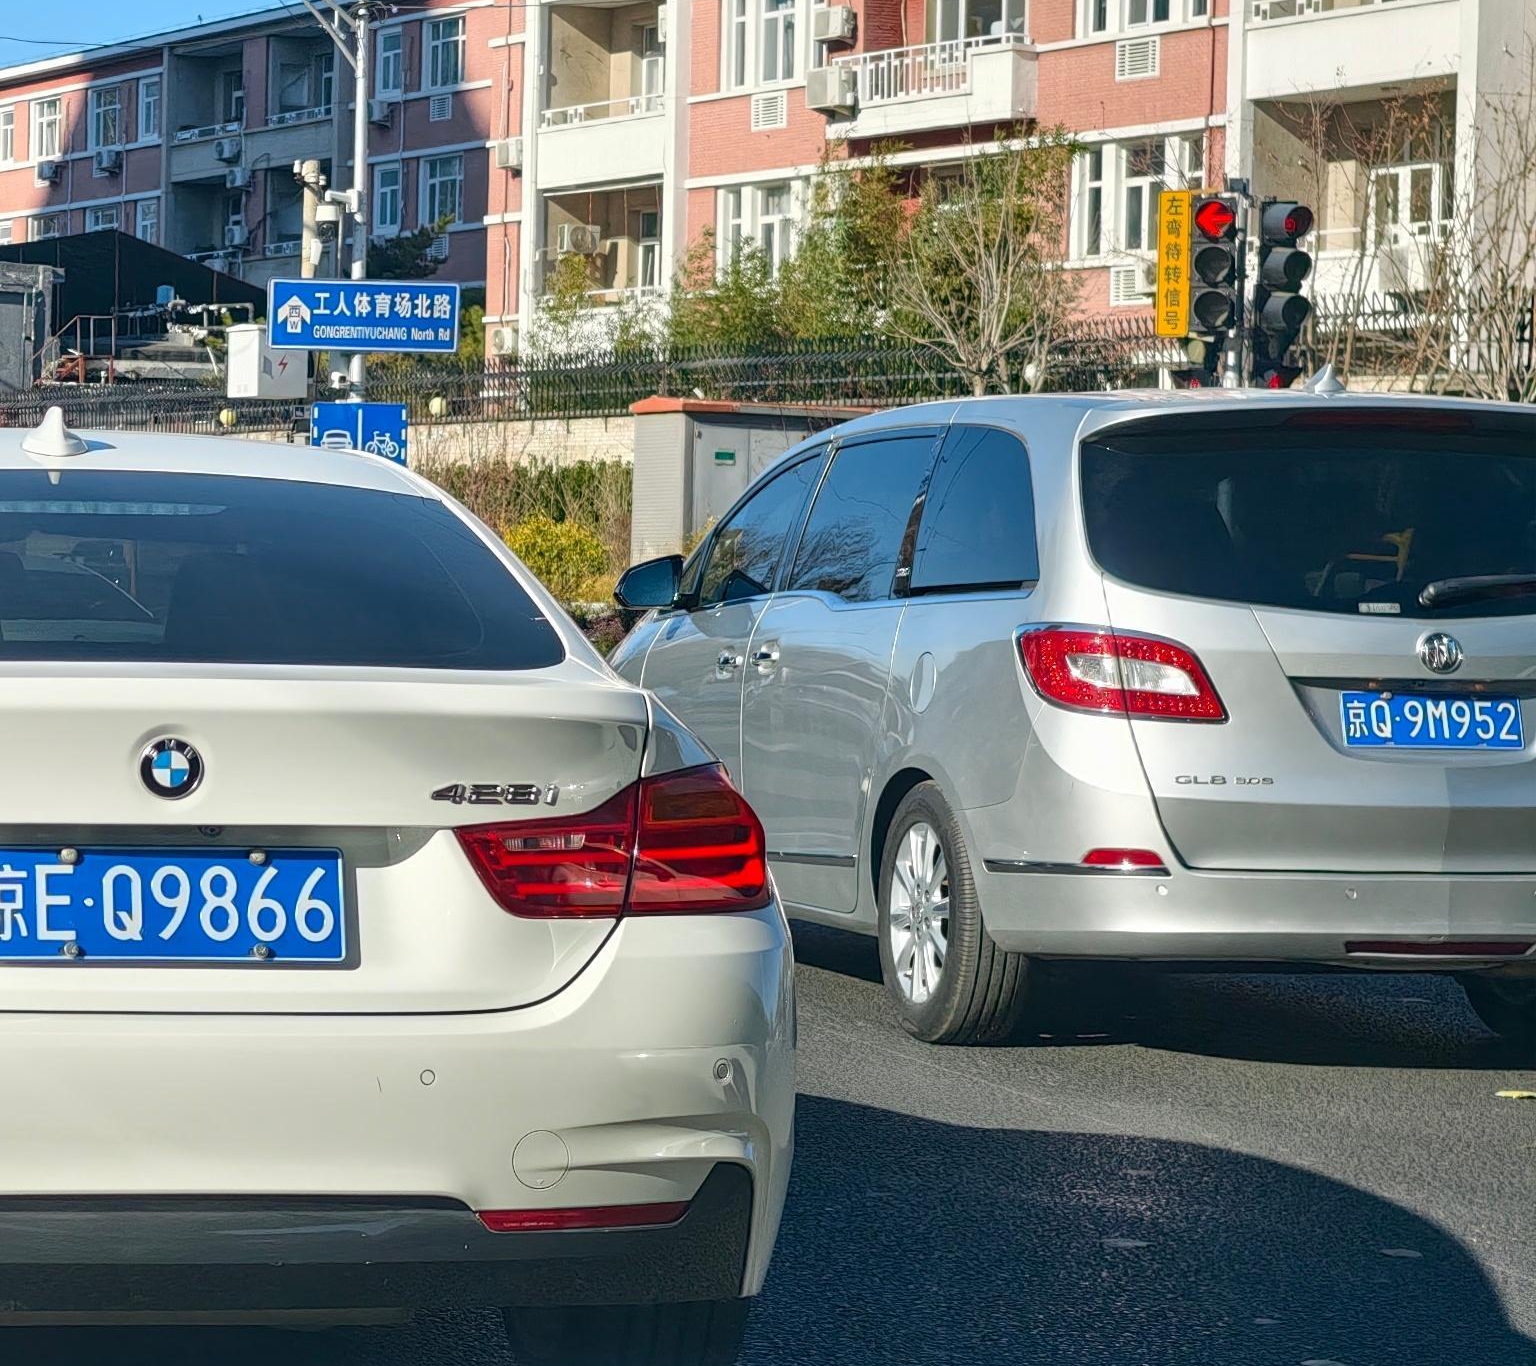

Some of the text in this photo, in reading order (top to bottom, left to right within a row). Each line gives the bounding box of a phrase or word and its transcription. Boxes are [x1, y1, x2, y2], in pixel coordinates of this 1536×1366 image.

[1164, 196, 1184, 330] 左弯待转信号
[288, 305, 301, 317] 西
[313, 291, 452, 320] 工人体育场北路
[289, 320, 299, 330] W
[313, 325, 450, 341] GONGRENTIYUCHANG North Rd
[1346, 699, 1518, 741] 京Q·9M952
[1175, 775, 1227, 785] GL8
[431, 784, 561, 807] 428i
